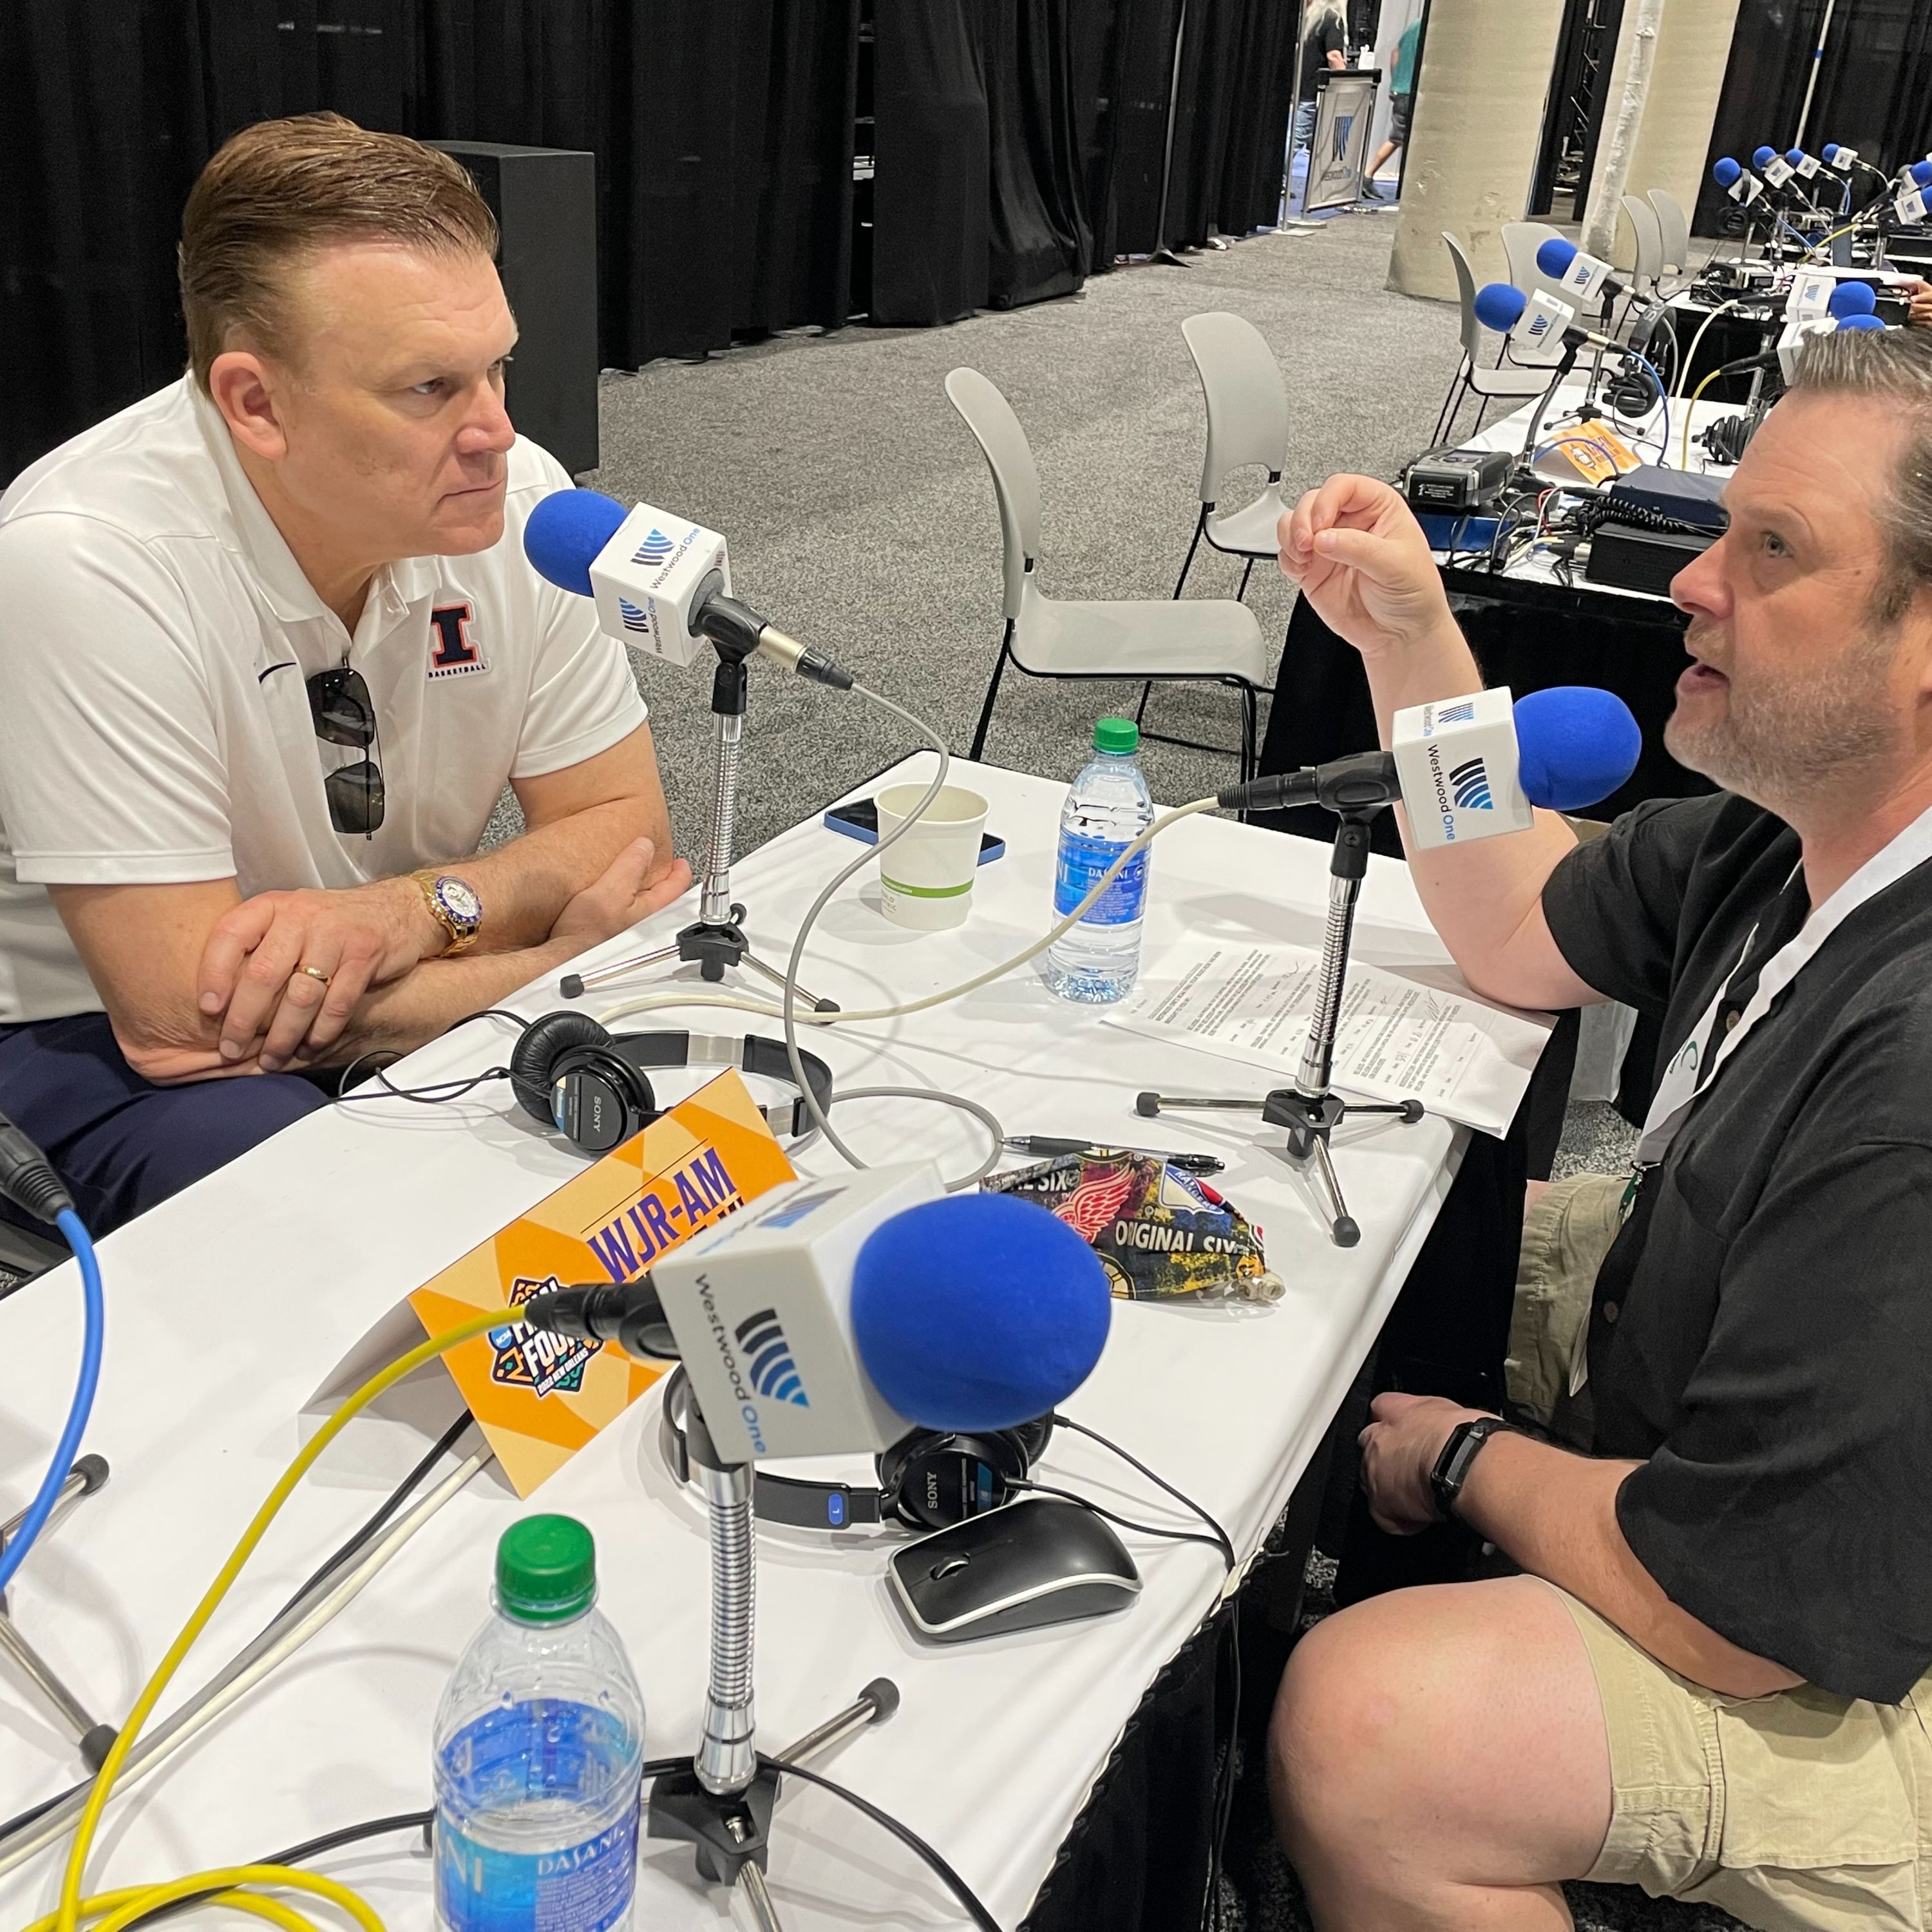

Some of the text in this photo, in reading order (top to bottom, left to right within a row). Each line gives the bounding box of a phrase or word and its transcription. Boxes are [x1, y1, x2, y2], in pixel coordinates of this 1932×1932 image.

[649, 528, 700, 589] Westwood One
[430, 603, 477, 668] I
[649, 612, 663, 654] Westwood
[428, 664, 486, 678] BASKETBALL
[1428, 744, 1451, 813] Westwood
[1443, 815, 1455, 840] One
[1089, 867, 1128, 879] DANI
[587, 1147, 738, 1283] WJR-AM
[537, 1347, 589, 1395] 2022 NEW ORLEANS
[695, 1273, 766, 1454] Westwood One
[927, 1472, 937, 1510] SONY
[538, 1827, 619, 1876] DASANI
